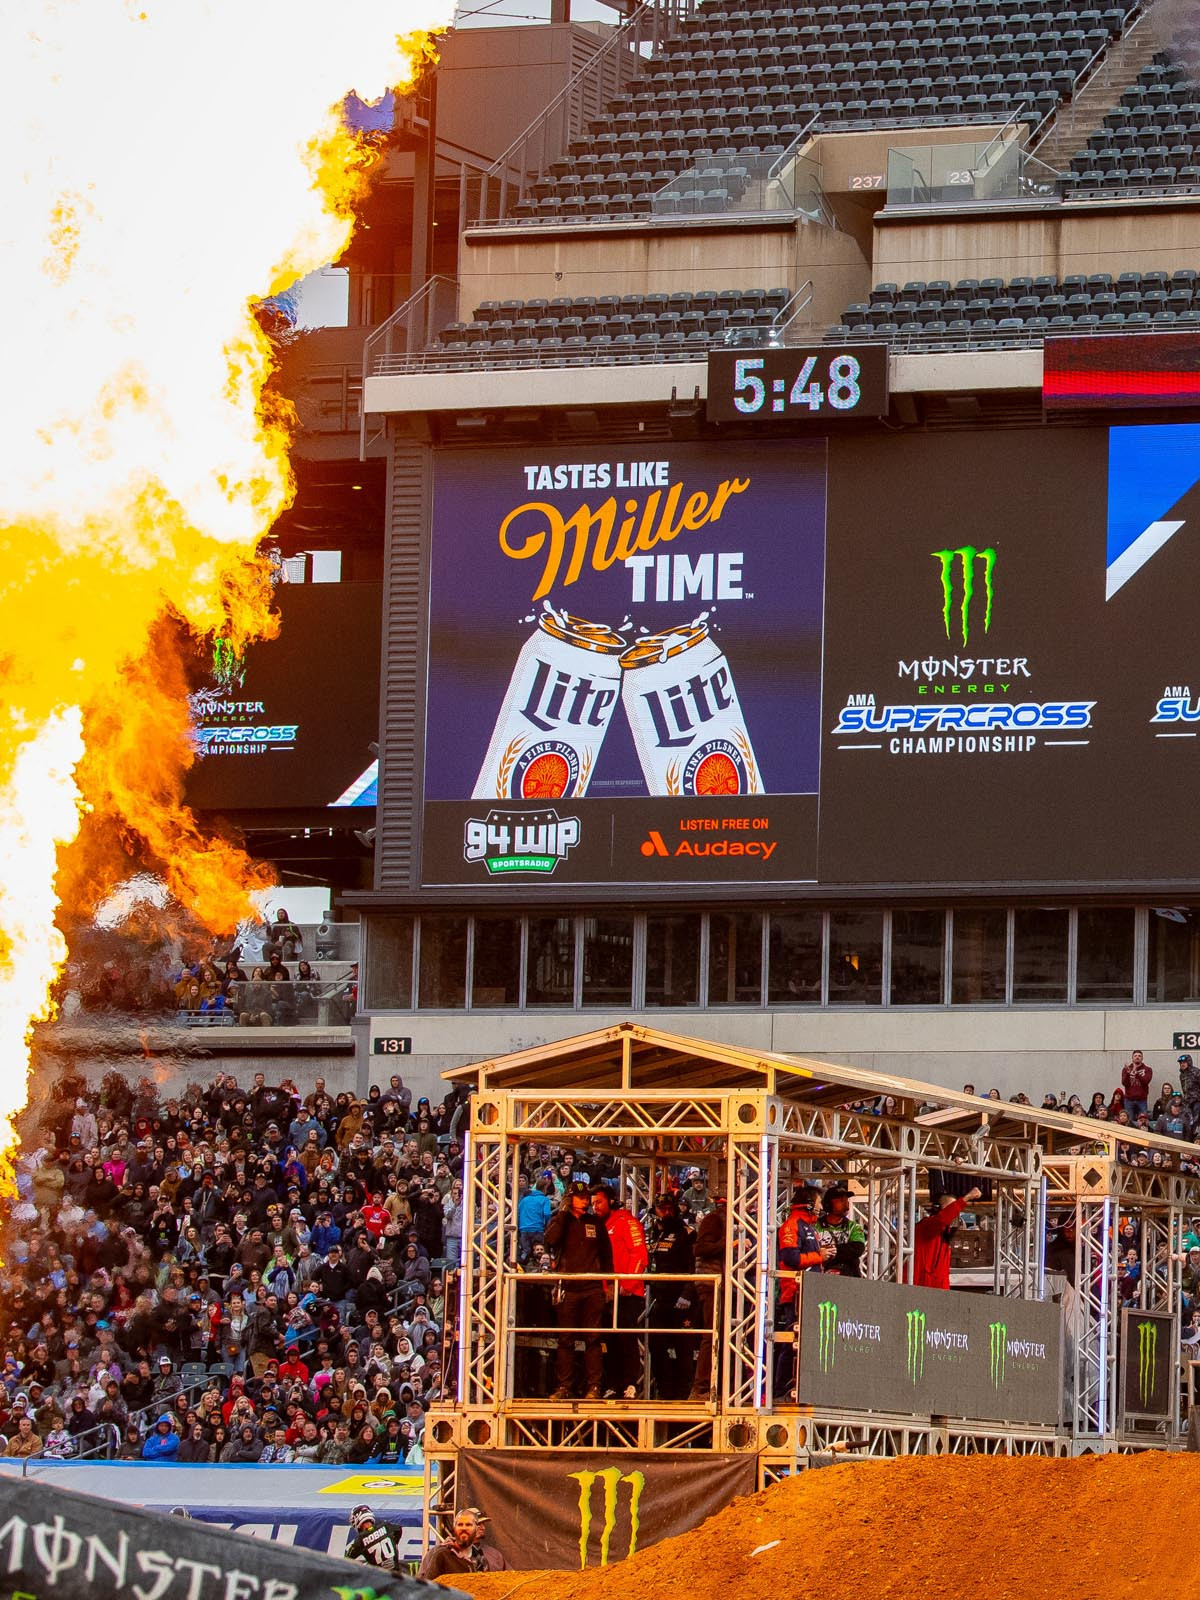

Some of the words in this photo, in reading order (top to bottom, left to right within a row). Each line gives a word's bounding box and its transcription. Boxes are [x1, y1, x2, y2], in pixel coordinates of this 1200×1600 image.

[851, 175, 883, 189] 237
[949, 170, 978, 185] 23
[733, 355, 861, 413] 5:48
[524, 463, 611, 491] TASTES
[616, 461, 670, 488] LIKE
[499, 477, 751, 602] Miller
[625, 552, 744, 602] TIME
[898, 656, 1031, 681] MONSTER
[519, 657, 619, 732] Lite
[919, 683, 1011, 694] ENERGY
[1163, 686, 1190, 698] AMA
[640, 665, 735, 748] Lite
[847, 694, 876, 707] AMA
[831, 701, 1097, 734] SUPERCROSS
[890, 735, 1036, 755] CHAMPIONSHIP
[525, 743, 551, 760] FINE
[556, 743, 578, 782] PILSNER
[685, 751, 704, 776] FINE
[706, 740, 742, 766] PILSNER
[680, 819, 719, 831] LISTEN
[722, 818, 749, 830] FREE
[752, 818, 768, 830] ON
[467, 821, 510, 859] 94
[514, 819, 579, 856] WIP
[675, 840, 778, 860] Audacy
[492, 859, 550, 869] SPORTSRADIO
[380, 1039, 405, 1052] 131
[837, 1319, 881, 1342] MONSTER
[926, 1329, 969, 1351] MONSTER
[1006, 1338, 1046, 1360] MONSTER
[362, 1526, 387, 1546] ROBIN
[367, 1537, 395, 1565] 70
